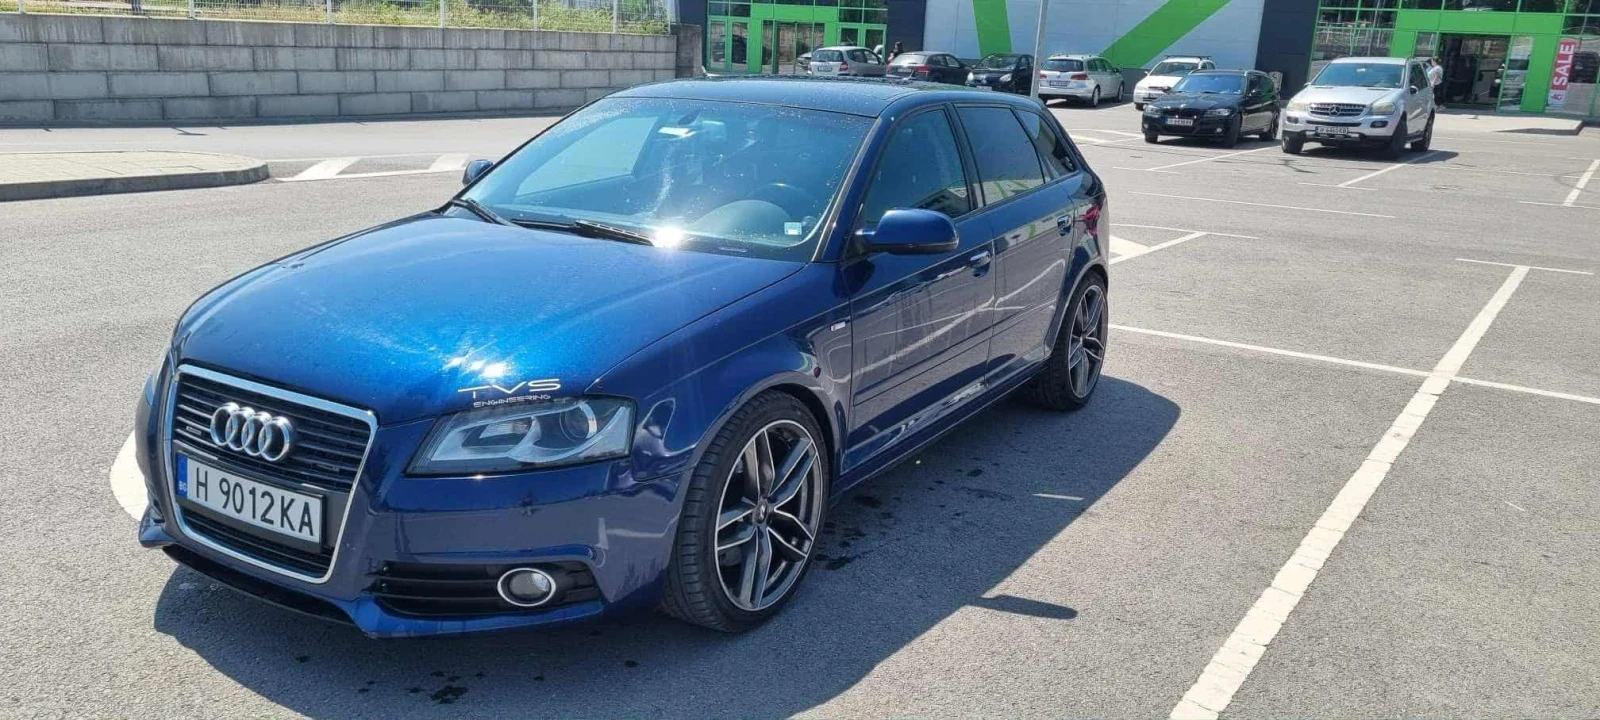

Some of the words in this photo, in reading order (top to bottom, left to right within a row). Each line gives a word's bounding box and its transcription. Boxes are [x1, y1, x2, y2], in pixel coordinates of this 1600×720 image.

[1553, 44, 1575, 86] SALE
[458, 379, 561, 399] TVS
[473, 394, 551, 408] ENGINEERING
[196, 467, 208, 502] H
